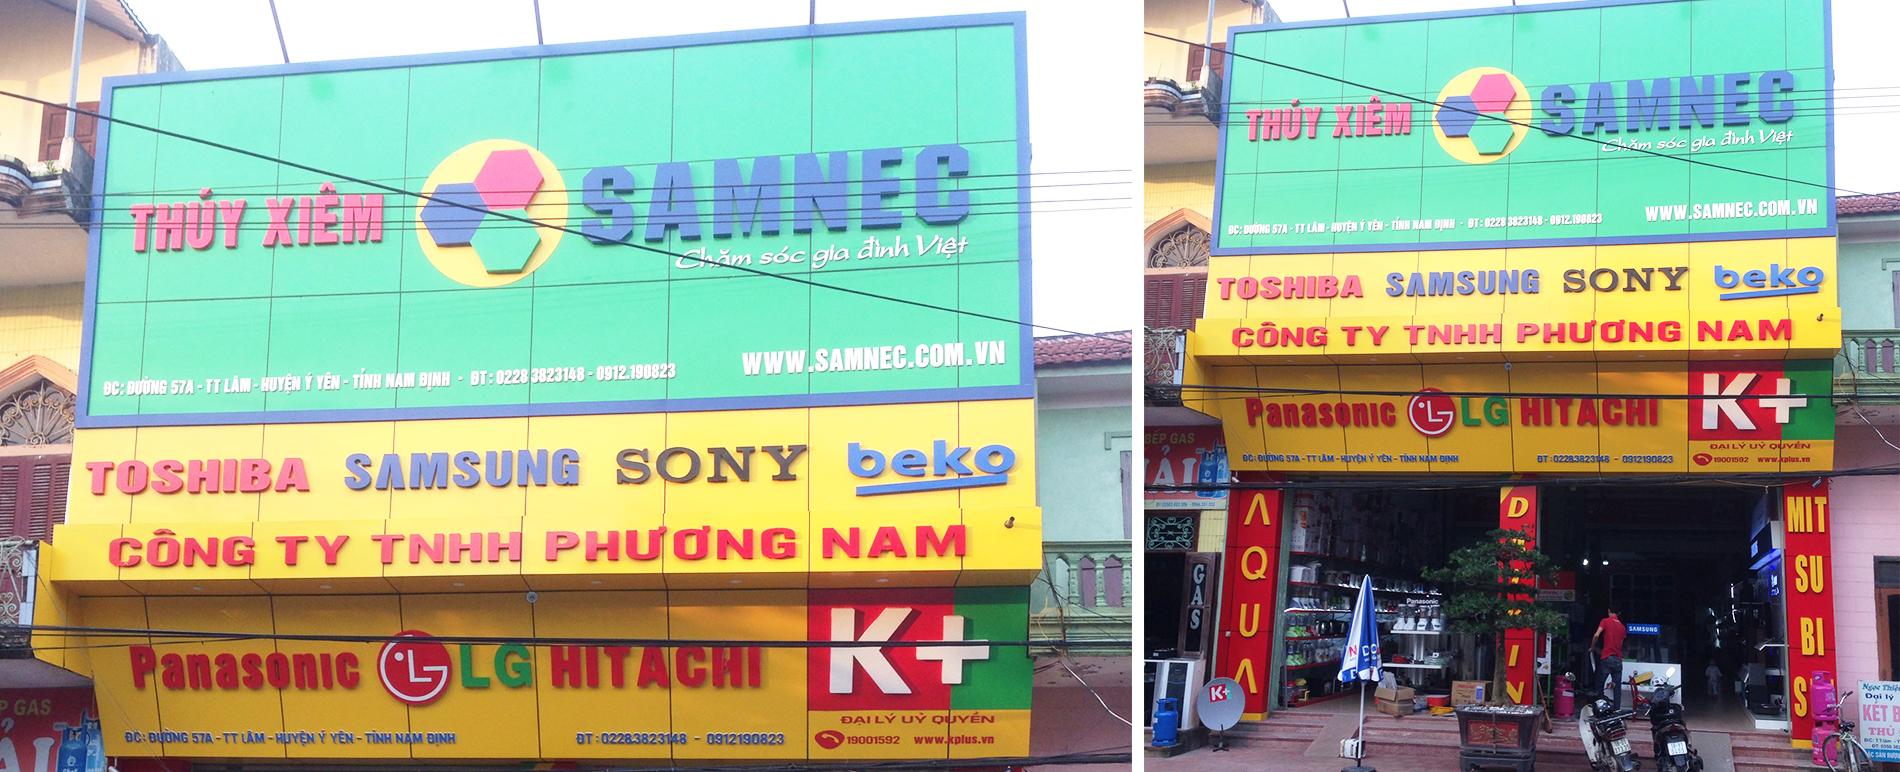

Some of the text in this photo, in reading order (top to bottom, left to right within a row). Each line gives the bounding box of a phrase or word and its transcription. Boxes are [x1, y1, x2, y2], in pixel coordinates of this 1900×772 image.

[1246, 95, 1412, 141] THÚY XIÊM
[1540, 69, 1794, 137] SAMNEC
[1602, 129, 1793, 152] Chăm sóc gia đình Việt
[581, 143, 970, 246] SAMNEC
[130, 182, 384, 252] THÚY XIÊM
[1272, 224, 1288, 234] 57A
[1295, 224, 1306, 233] TT
[1307, 221, 1325, 233] LÂM
[1331, 220, 1357, 234] HUYỆN
[1360, 219, 1365, 232] Ý
[1368, 219, 1383, 231] YÊN
[1391, 216, 1410, 230] TỈNH
[1413, 219, 1432, 230] NAM
[1434, 219, 1455, 232] ĐỊNH
[1485, 217, 1506, 228] 0228
[1507, 216, 1543, 227] 3823148
[1550, 213, 1603, 225] 0912.190823
[1645, 199, 1818, 222] WWW.SAMNEC.COM.VN
[676, 234, 968, 269] Chăm sóc gia đình Việt
[1217, 264, 1824, 300] TOSHIBA SAMSUNG SONY beko
[1231, 319, 1792, 346] CÔNG TY TNHH PHƯƠNG NAM
[742, 341, 1006, 376] WWW.SAMNEC.COM.VN
[127, 376, 168, 396] ĐƯỜNG
[171, 380, 194, 394] 57A
[206, 379, 222, 394] TT
[224, 376, 251, 394] LÂM
[261, 374, 300, 395] HUYỆN
[304, 372, 313, 391] Ý
[316, 372, 340, 390] YÊN
[352, 368, 382, 389] TỈNH
[386, 372, 415, 388] NAM
[419, 372, 450, 391] ĐỊNH
[496, 369, 528, 385] 0228
[530, 367, 586, 384] 3823148
[596, 363, 676, 382] 0912.190823
[1245, 398, 1396, 427] Panasonic
[1461, 396, 1508, 426] LG
[1520, 398, 1658, 426] HITACHI
[1170, 433, 1194, 444] GAS
[1769, 440, 1811, 450] QUYỀN
[86, 440, 1016, 496] TOSHIBA SAMSUNG SONY beko
[1286, 454, 1300, 462] 57A
[1319, 452, 1334, 462] LÂM
[1341, 453, 1367, 464] HUYỆN
[1376, 452, 1392, 462] YÊN
[1439, 454, 1459, 464] ĐỊNH
[1622, 454, 1673, 463] 0912190823
[108, 524, 967, 567] CÔNG TY TNHH PHƯƠNG NAM
[1190, 564, 1205, 630] GAS
[130, 645, 360, 690] Panasonic
[460, 643, 532, 688] LG
[550, 645, 762, 688] HITACHI
[830, 607, 990, 695] K+
[14, 698, 51, 716] GAS
[840, 715, 870, 726] ĐẠI
[872, 713, 896, 725] LÝ
[932, 710, 996, 725] QUYỀN
[148, 728, 189, 744] ĐƯỜNG
[192, 731, 214, 744] 57A
[223, 732, 238, 744] TT
[242, 729, 266, 744] LÂM
[276, 730, 315, 746] HUYỆN
[318, 729, 326, 744] Ý
[330, 729, 354, 744] YÊN
[396, 732, 423, 744] NAM
[426, 732, 456, 746] ĐỊNH
[707, 732, 785, 746] 0912190823
[846, 734, 995, 746] 19001592 www.kplus.vn
